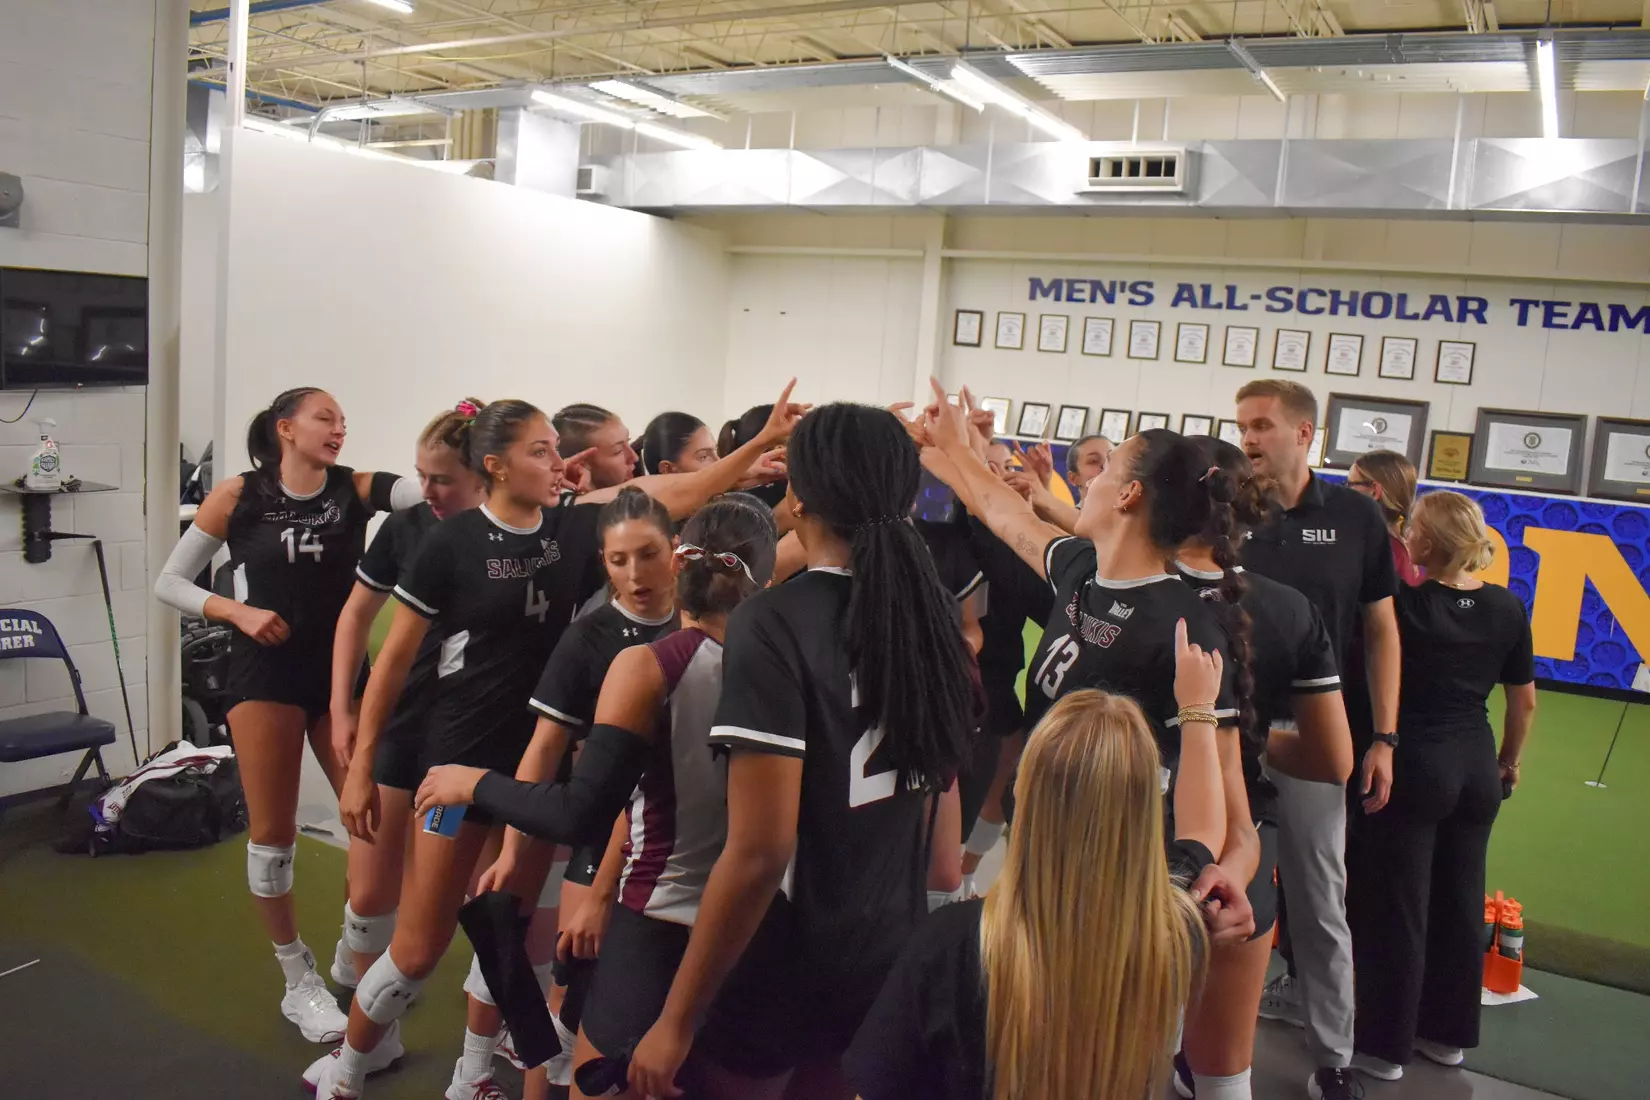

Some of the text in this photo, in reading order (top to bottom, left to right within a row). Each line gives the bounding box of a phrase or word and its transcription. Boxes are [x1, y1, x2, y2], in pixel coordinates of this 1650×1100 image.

[1028, 277, 1650, 334] MEN'S ALL-SCHOLAR TEAM
[280, 527, 324, 563] 14
[1302, 528, 1336, 542] SIU
[525, 579, 550, 623] 4
[0, 618, 43, 635] CIAL
[0, 634, 36, 650] RER
[1034, 633, 1080, 700] 13
[431, 805, 445, 829] RADE
